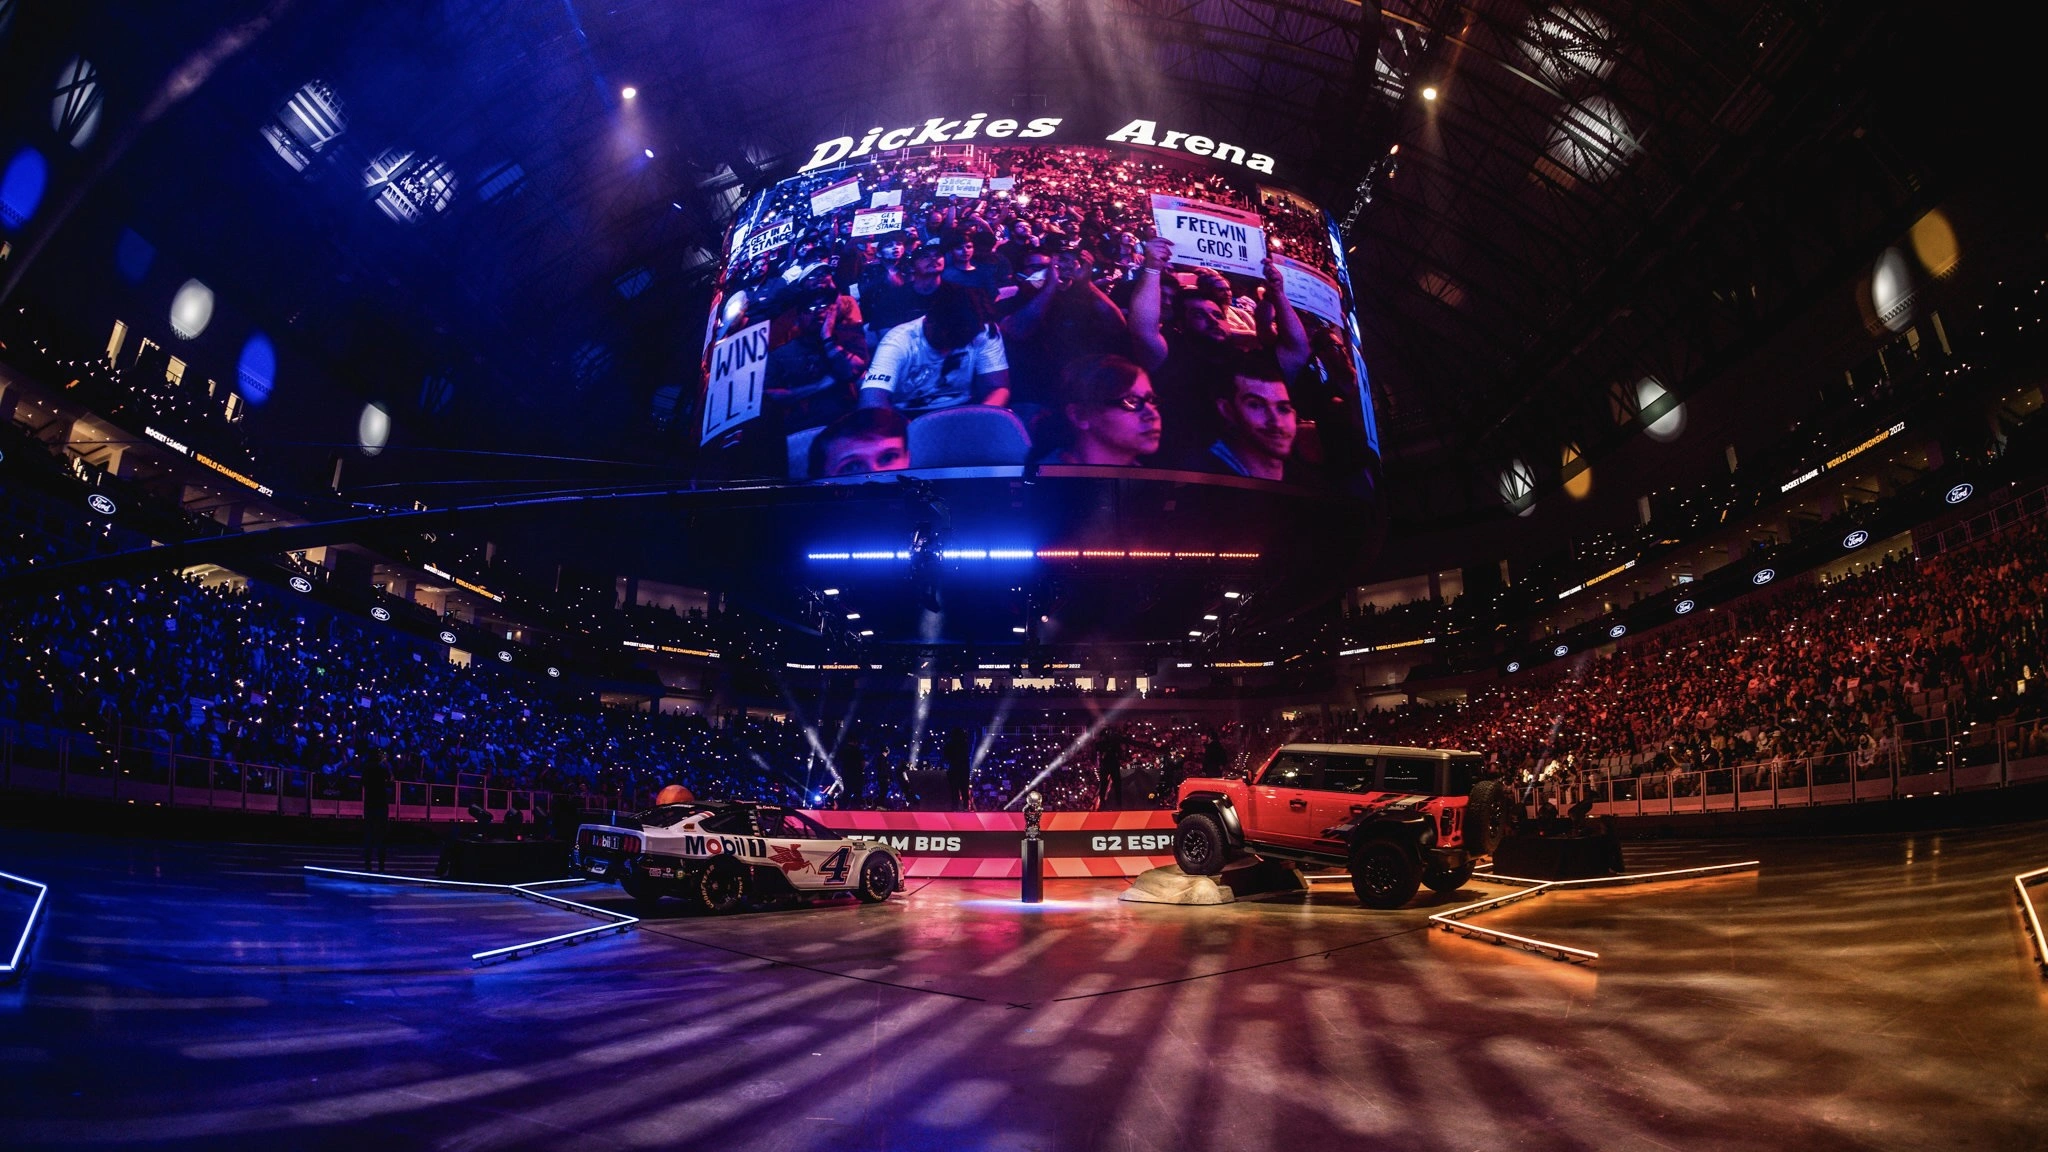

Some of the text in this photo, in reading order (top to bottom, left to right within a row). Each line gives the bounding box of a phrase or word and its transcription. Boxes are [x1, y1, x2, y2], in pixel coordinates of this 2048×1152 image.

[797, 113, 1276, 174] Dickies Arena
[751, 223, 791, 247] GET IN A
[876, 223, 901, 231] STANCE
[1176, 215, 1246, 244] FREEWIN
[1197, 237, 1233, 259] GROS
[716, 326, 769, 381] WINS
[145, 426, 273, 497] ROCKET LEAGUE WORLD CHAMPIONSHIP 2022
[1781, 421, 1905, 493] ROCKET LEAGUE WORLD CHAMPIONSHIP 2022
[92, 496, 112, 512] Ford
[1950, 487, 1968, 502] Ford
[1847, 533, 1864, 546] Ford
[685, 835, 746, 857] Mobil
[915, 836, 961, 852] BDS
[1092, 835, 1174, 851] G2 ESP
[818, 846, 852, 886] 4
